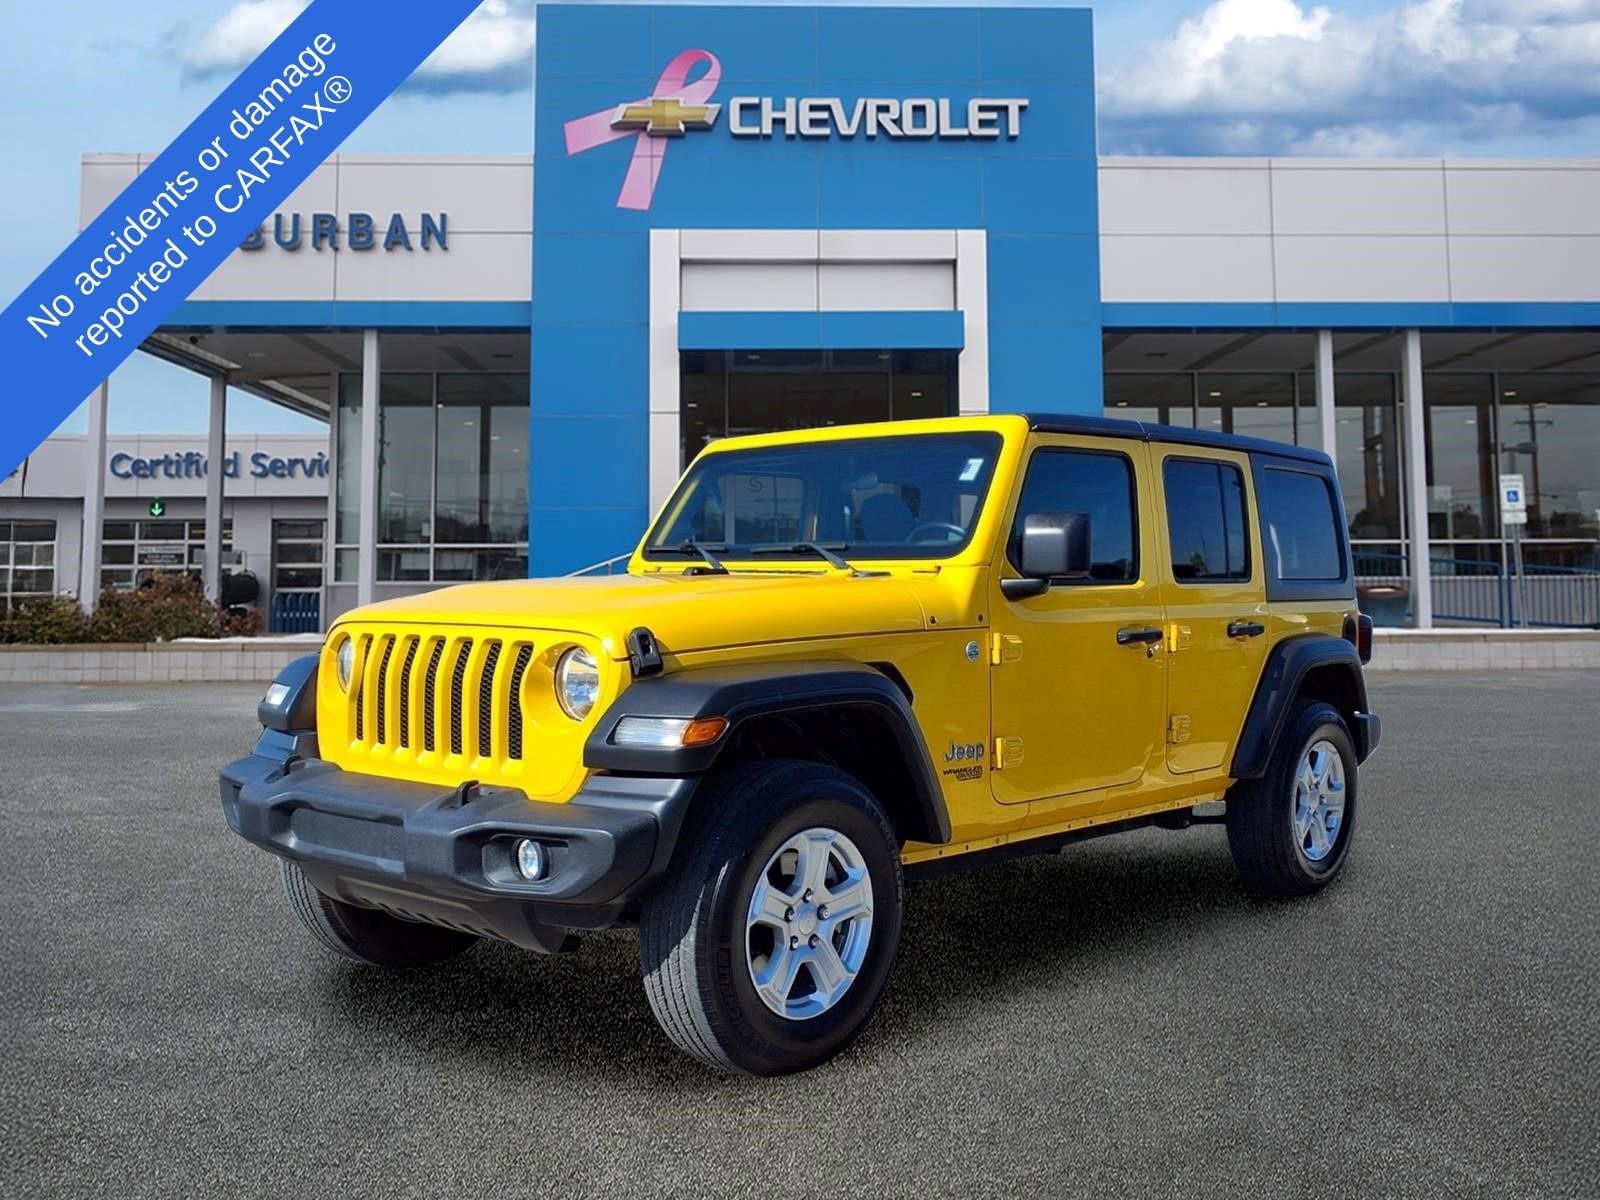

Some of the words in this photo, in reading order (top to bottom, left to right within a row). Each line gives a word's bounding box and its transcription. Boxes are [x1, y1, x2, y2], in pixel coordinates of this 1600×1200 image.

[729, 97, 1029, 138] CHEVROLET
[110, 452, 240, 479] Certifid
[944, 742, 984, 760] Jeep
